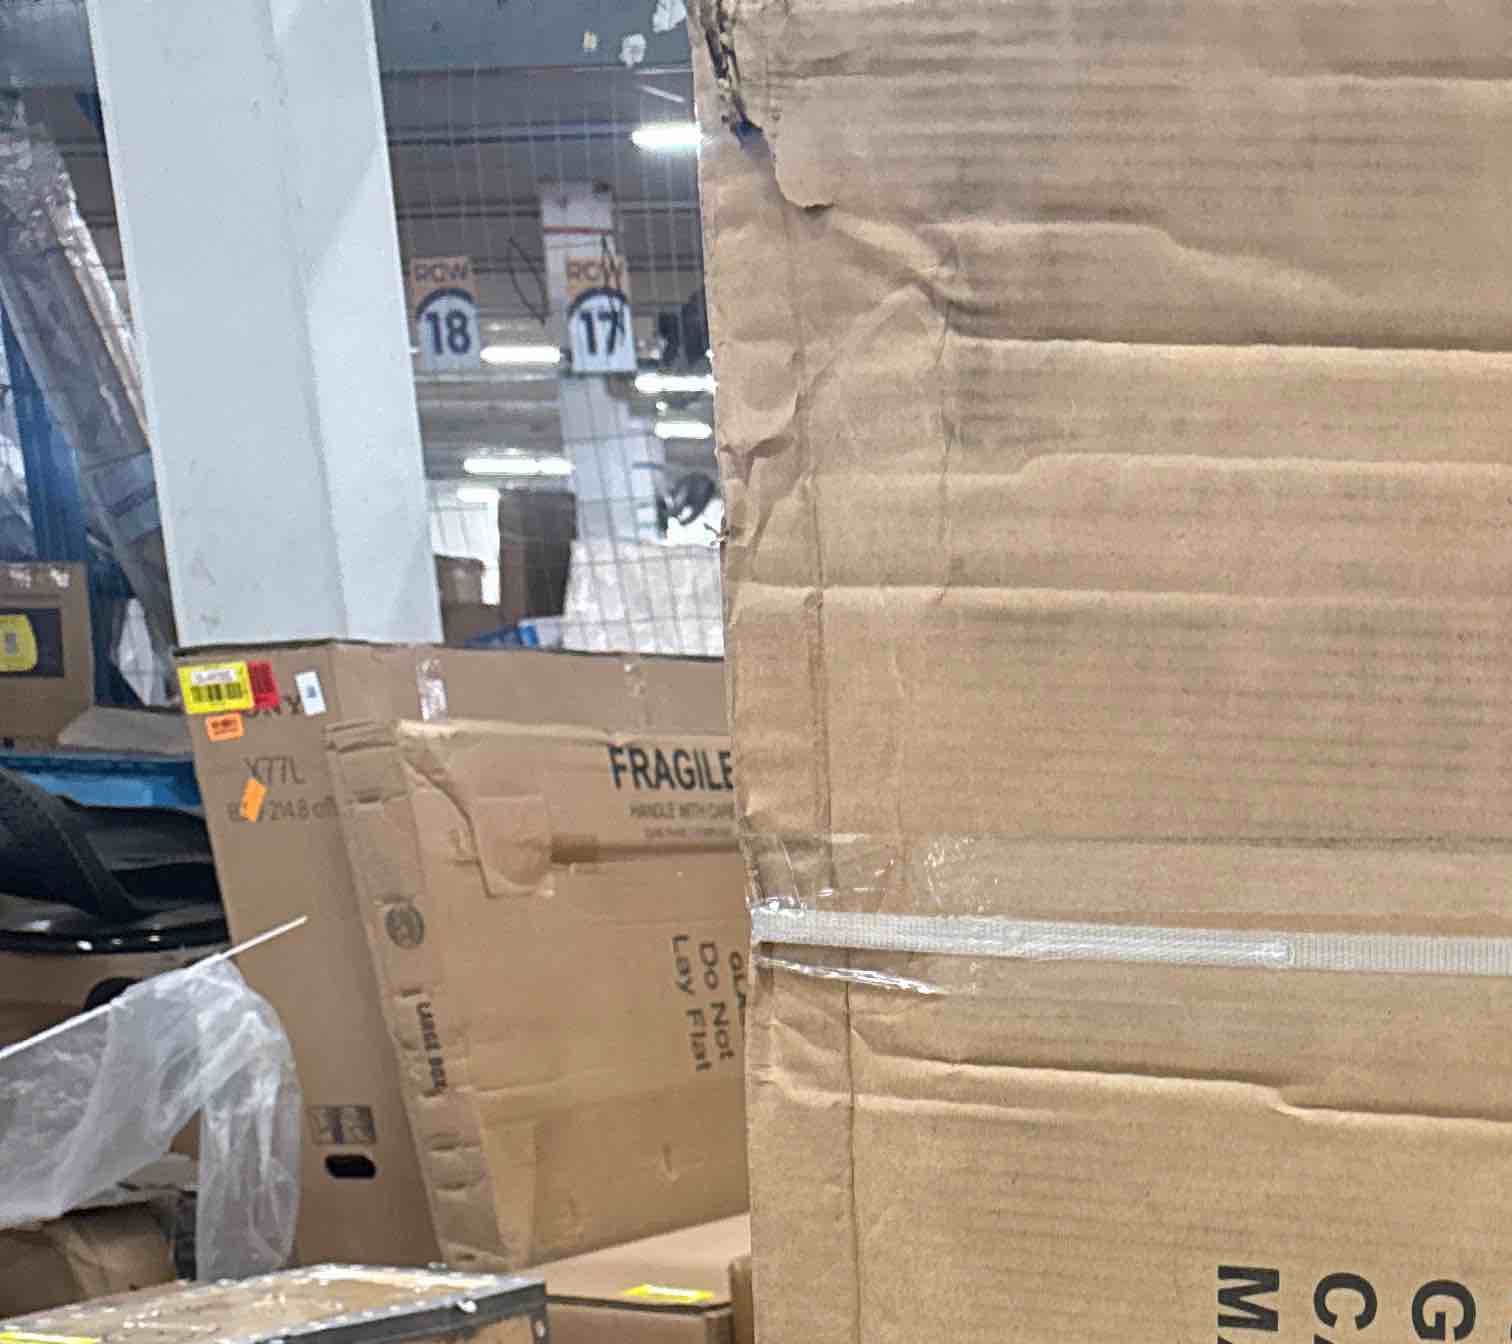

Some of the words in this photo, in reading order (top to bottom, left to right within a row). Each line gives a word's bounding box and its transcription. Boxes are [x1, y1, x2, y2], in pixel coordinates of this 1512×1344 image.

[425, 310, 470, 355] 18
[580, 311, 621, 354] 17
[609, 744, 733, 790] FRAGILE
[672, 934, 696, 995] Lay
[686, 1008, 712, 1072] Flat
[699, 941, 719, 990] Do
[711, 1002, 735, 1059] Not
